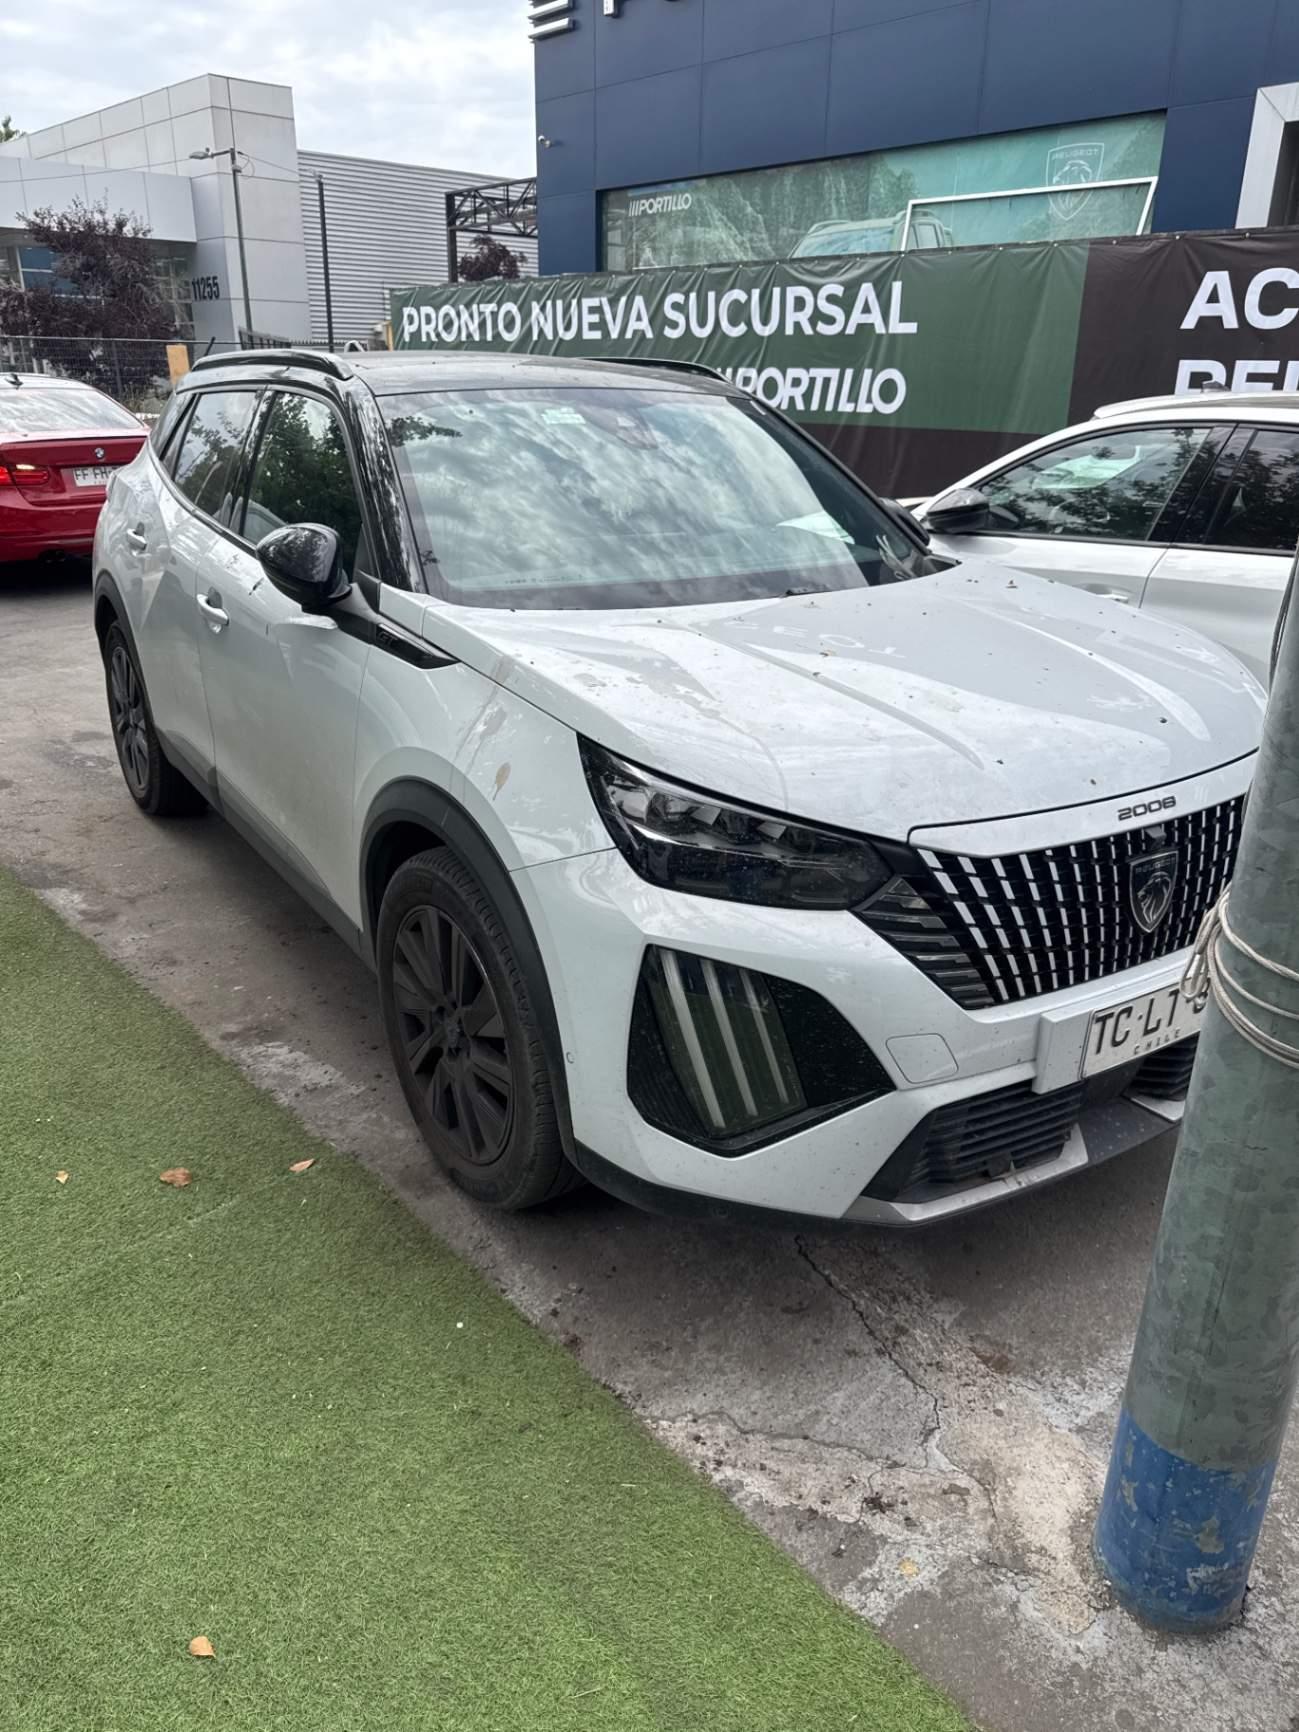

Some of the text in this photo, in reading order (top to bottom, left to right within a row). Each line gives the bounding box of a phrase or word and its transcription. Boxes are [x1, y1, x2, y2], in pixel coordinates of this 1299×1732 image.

[192, 276, 220, 301] 11255
[402, 280, 918, 343] PRONTO NUEVA SUCURSAL
[1117, 795, 1177, 821] 2008
[1134, 1029, 1181, 1056] CHILE
